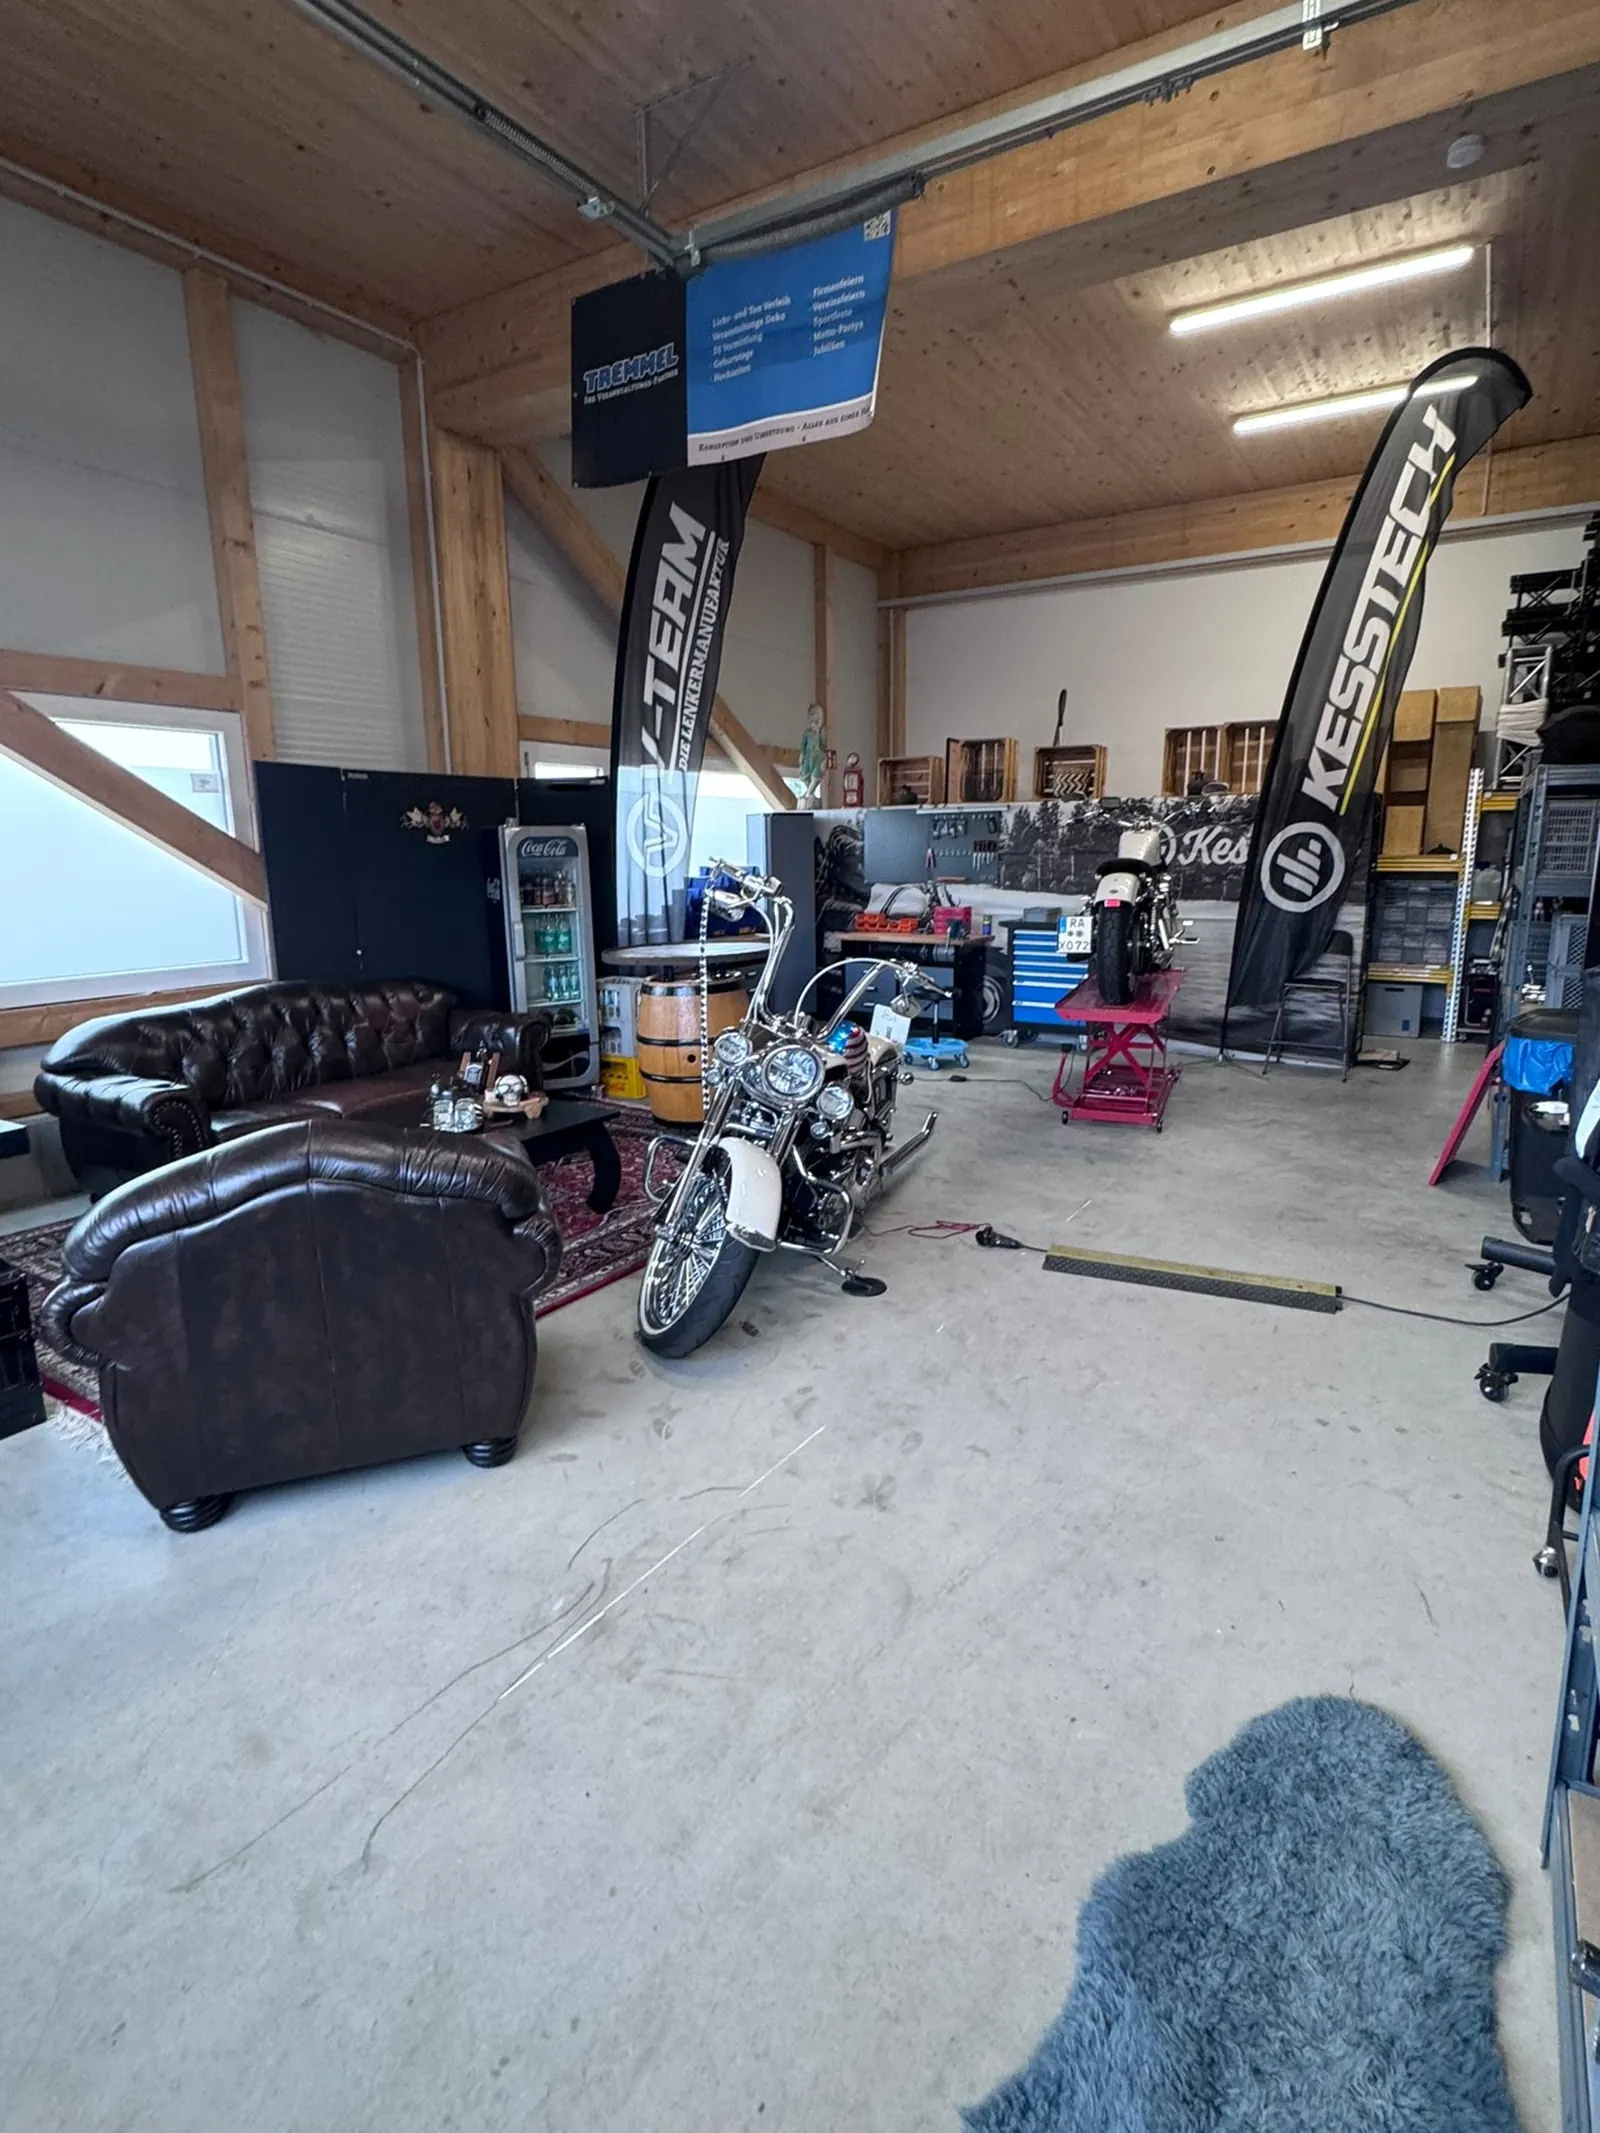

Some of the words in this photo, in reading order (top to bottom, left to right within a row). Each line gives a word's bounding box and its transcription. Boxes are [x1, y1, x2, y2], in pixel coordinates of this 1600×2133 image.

[583, 342, 680, 394] TREMMEL
[1302, 405, 1456, 811] KESSTECH
[683, 538, 729, 741] LENKERMANUFAKTUR
[679, 740, 691, 771] DIE
[1069, 918, 1085, 928] RA
